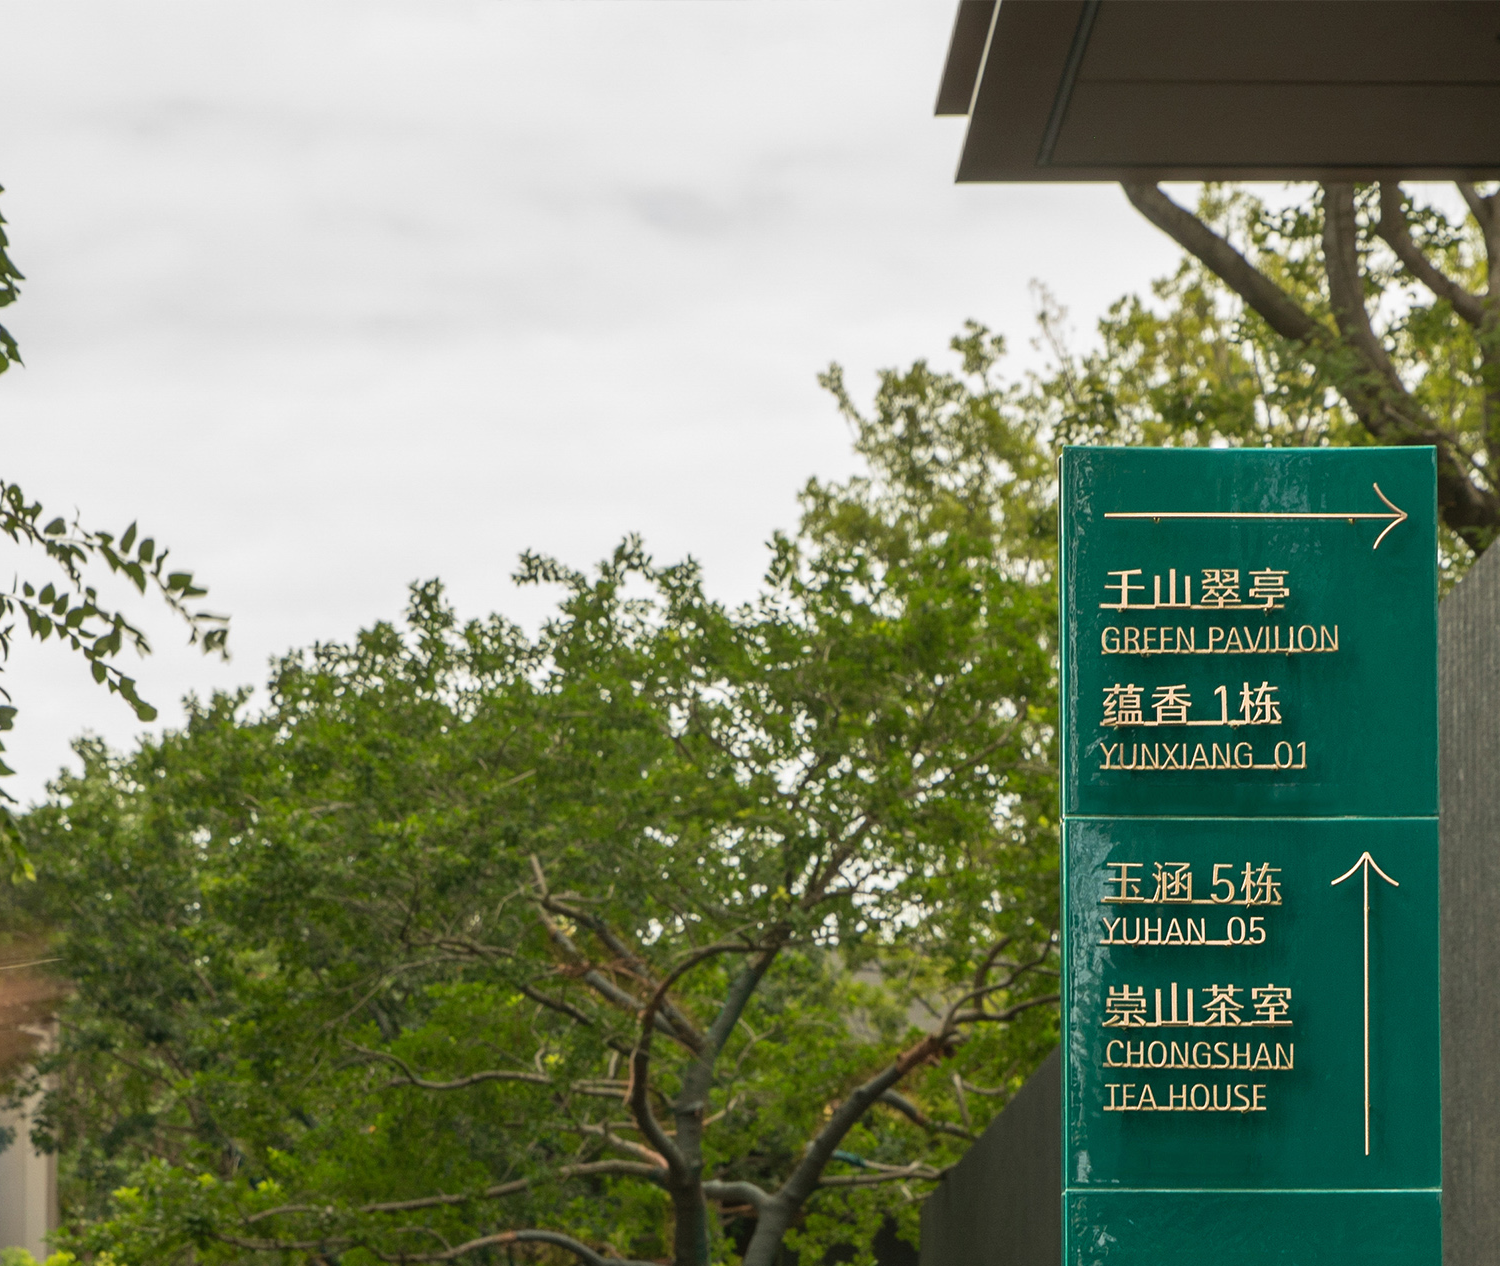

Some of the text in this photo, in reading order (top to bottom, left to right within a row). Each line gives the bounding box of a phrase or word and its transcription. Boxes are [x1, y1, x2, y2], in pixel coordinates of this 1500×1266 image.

[1103, 567, 1290, 609] 千山翠亭
[1101, 625, 1339, 654] GREEN PAVILION
[1102, 681, 1282, 726] 蕴香 1栋
[1100, 741, 1307, 770] YUNXIANG 01
[1104, 861, 1282, 905] 玉涵 5栋
[1102, 916, 1266, 945] YUHAN 05
[1102, 982, 1293, 1027] 崇山茶室
[1104, 1040, 1294, 1070] CHONGSHAN
[1104, 1083, 1267, 1111] TEA HOUSE
